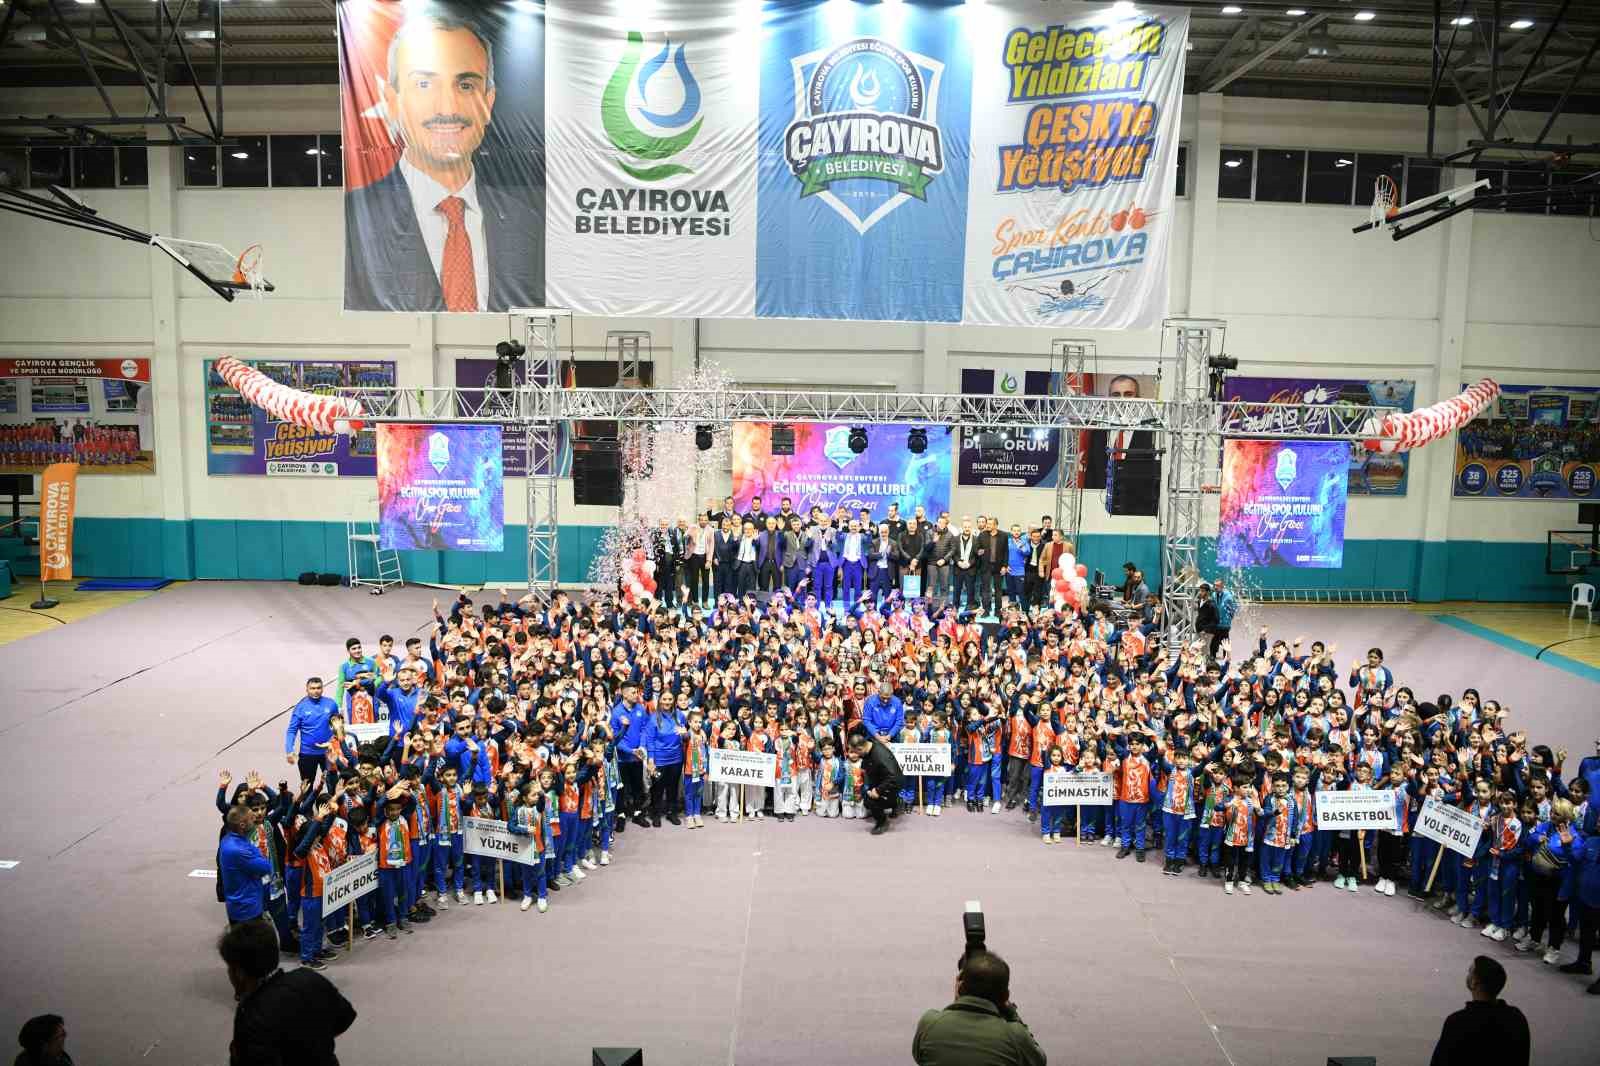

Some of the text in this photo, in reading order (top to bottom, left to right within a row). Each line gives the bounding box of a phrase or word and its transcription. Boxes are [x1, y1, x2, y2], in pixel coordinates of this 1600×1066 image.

[1012, 60, 1145, 97] Yıldızları
[790, 118, 937, 168] ÇAYIROVA
[1027, 103, 1153, 152] ÇESK'te
[1003, 144, 1150, 187] Yetişiyor
[576, 188, 729, 213] ÇAYIROVA
[992, 208, 1109, 256] Spor Kenti
[992, 232, 1148, 281] ÇAYIROVA
[15, 360, 57, 368] ÇAYIROVA
[819, 483, 854, 494] SPOR
[45, 482, 60, 550] ÇAYIROVA
[720, 766, 764, 779] KARATE
[900, 763, 945, 773] YUNLARI
[904, 754, 933, 763] HALK
[1322, 810, 1393, 822] BASKETBOL
[1423, 816, 1472, 847] VOLEYBOL
[479, 836, 519, 854] YÜZME
[327, 883, 351, 906] KİCK
[352, 869, 379, 891] BOKS
